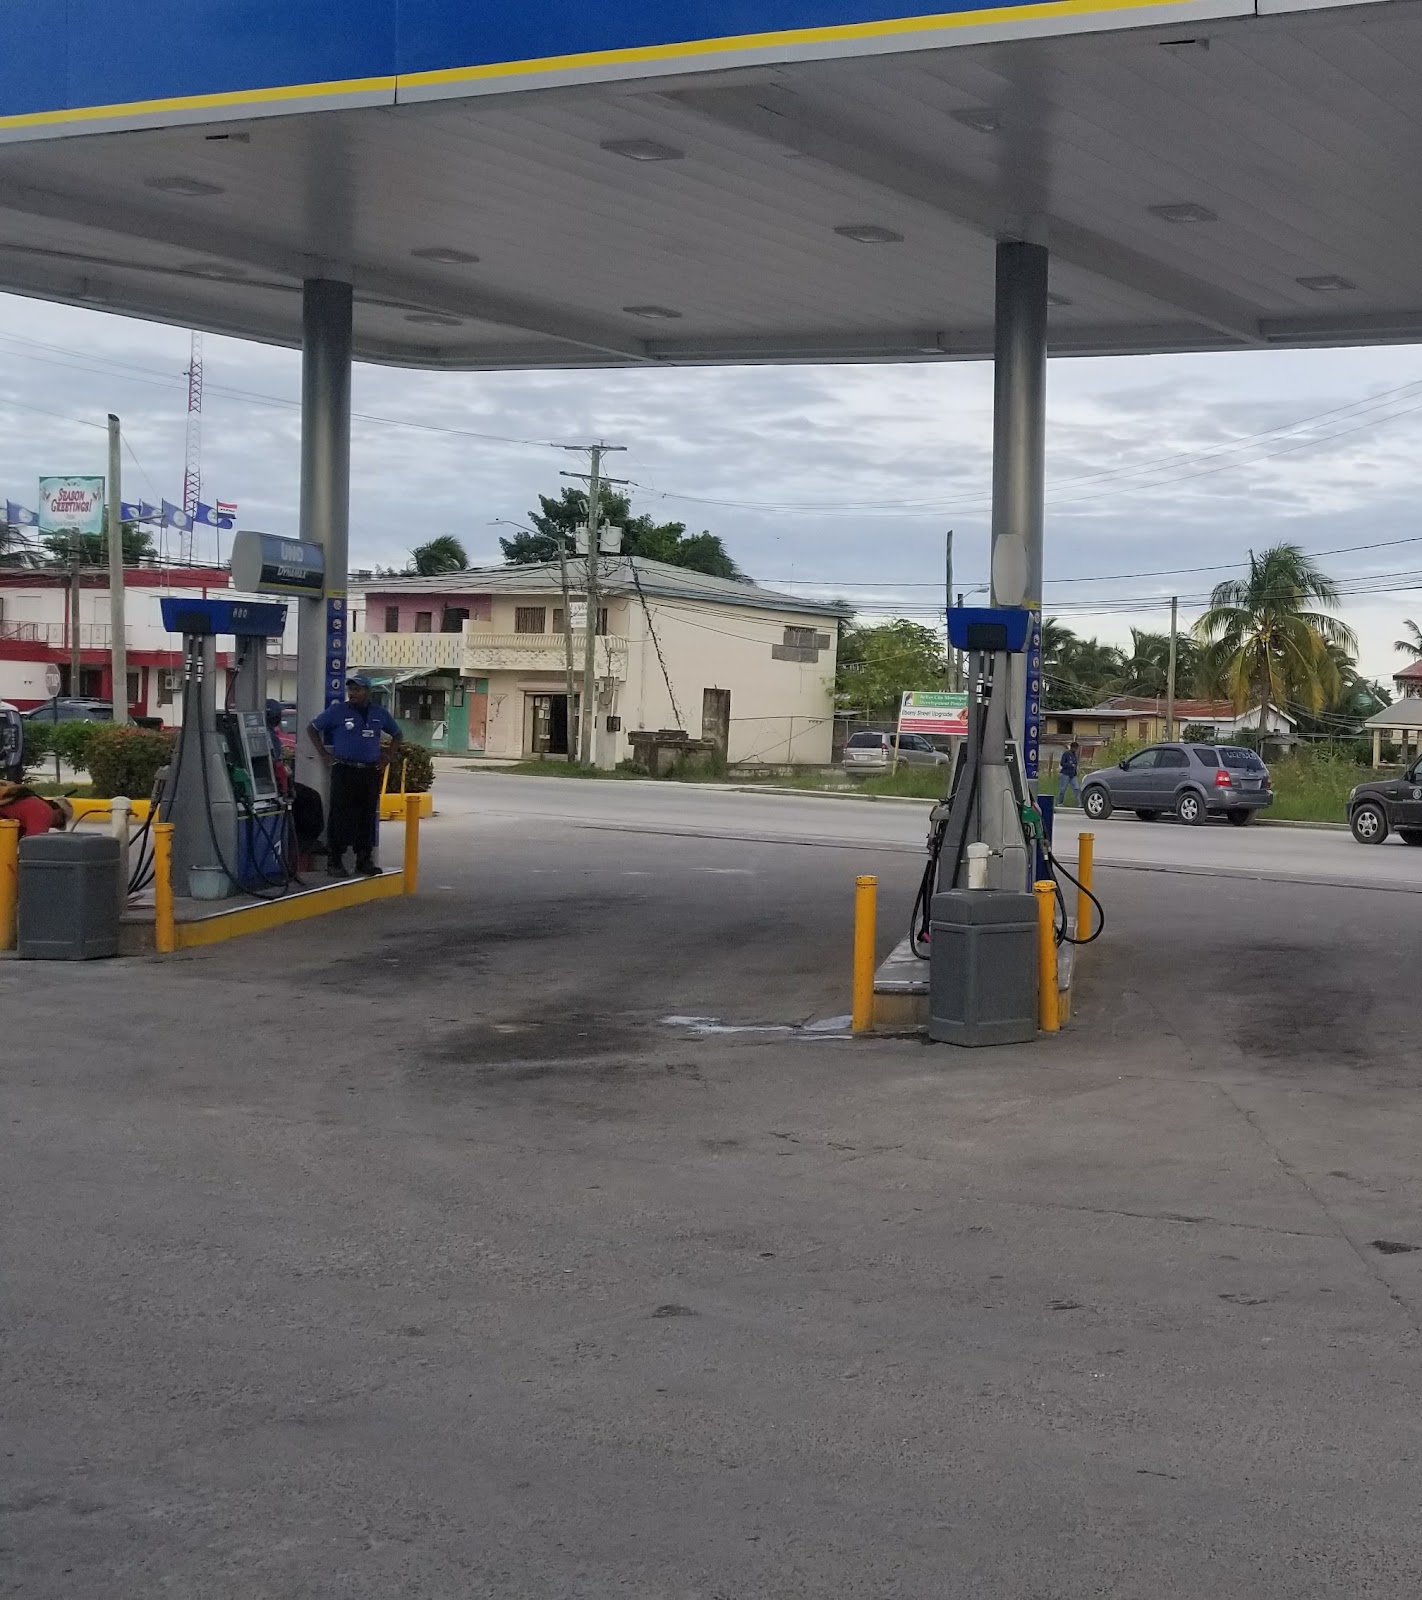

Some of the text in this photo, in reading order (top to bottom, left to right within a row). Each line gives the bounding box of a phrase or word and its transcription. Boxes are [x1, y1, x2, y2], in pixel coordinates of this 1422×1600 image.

[58, 488, 85, 501] SEASON
[51, 499, 93, 512] GREETINGS!
[280, 541, 304, 562] UNO
